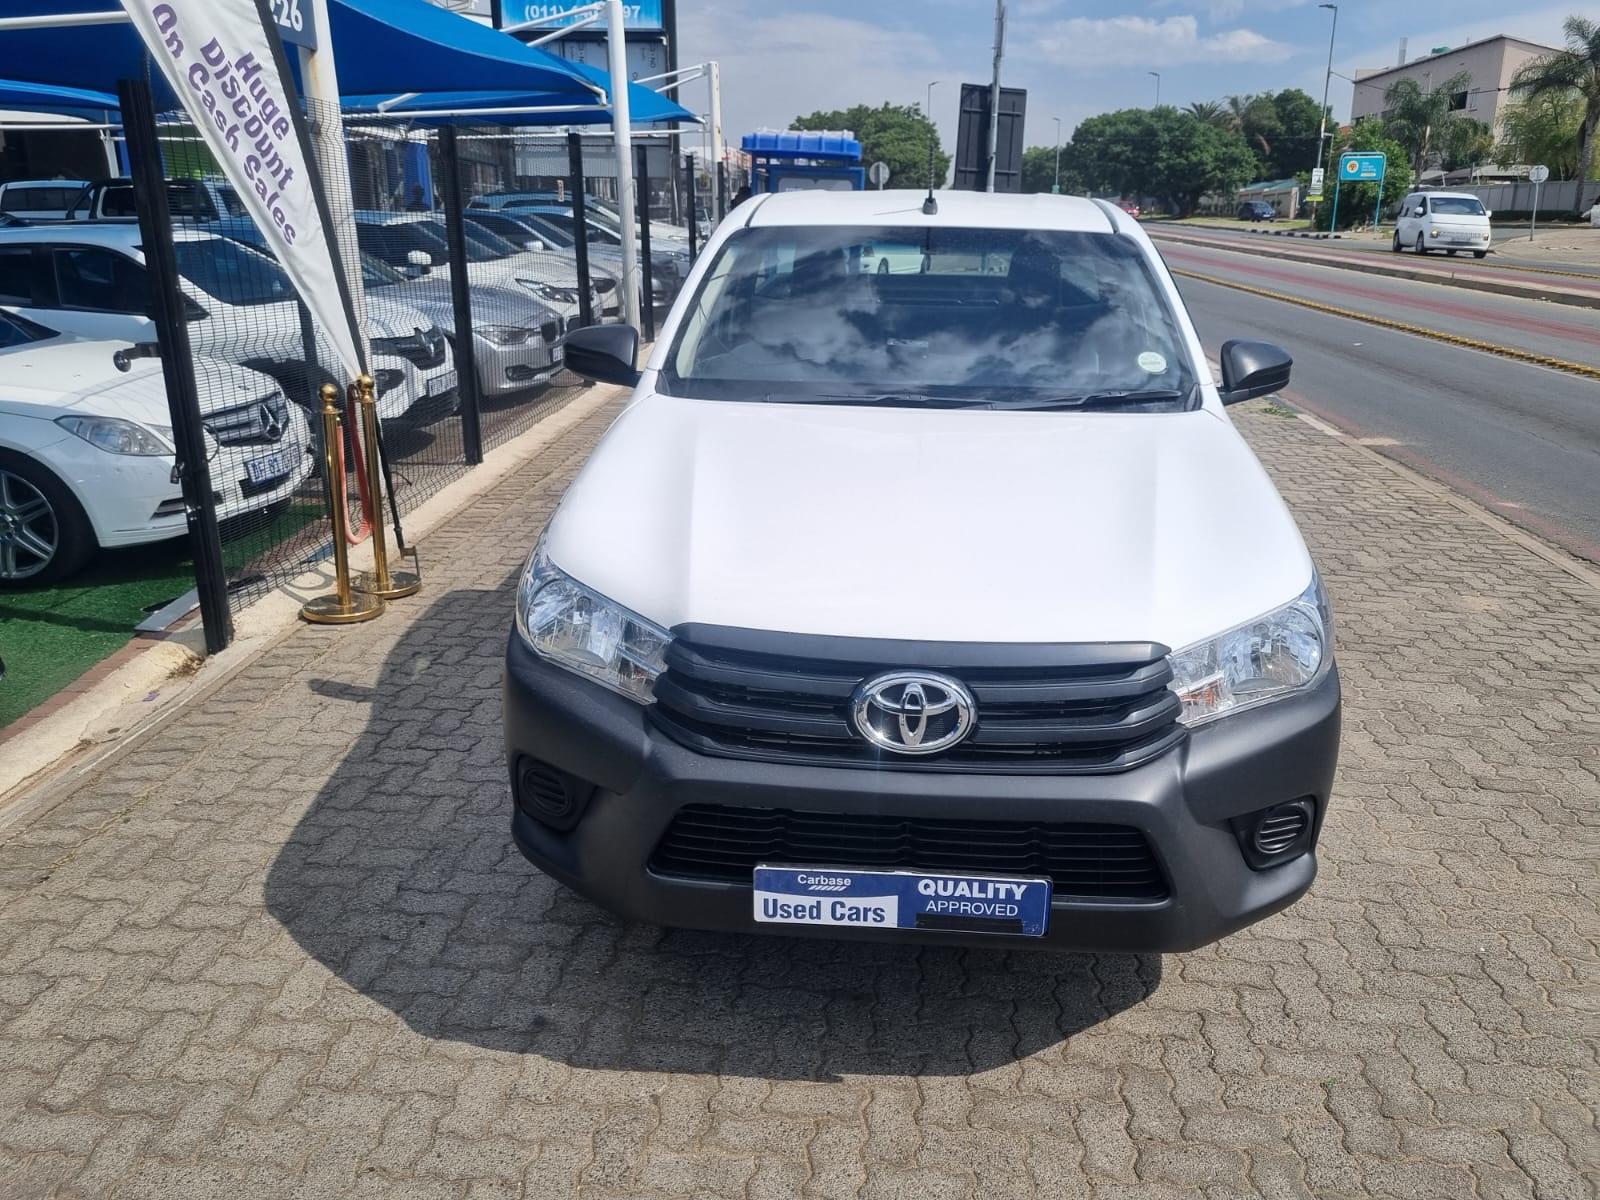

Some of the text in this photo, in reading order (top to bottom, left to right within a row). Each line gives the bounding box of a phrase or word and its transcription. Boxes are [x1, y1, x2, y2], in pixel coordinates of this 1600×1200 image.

[234, 51, 290, 141] Huge
[152, 3, 296, 246] On Cash Sales
[200, 36, 294, 191] Discount
[797, 874, 851, 887] Carbase
[917, 878, 1027, 901] QUALITY
[763, 898, 886, 924] Used Cars
[926, 900, 1018, 917] APPROVED
